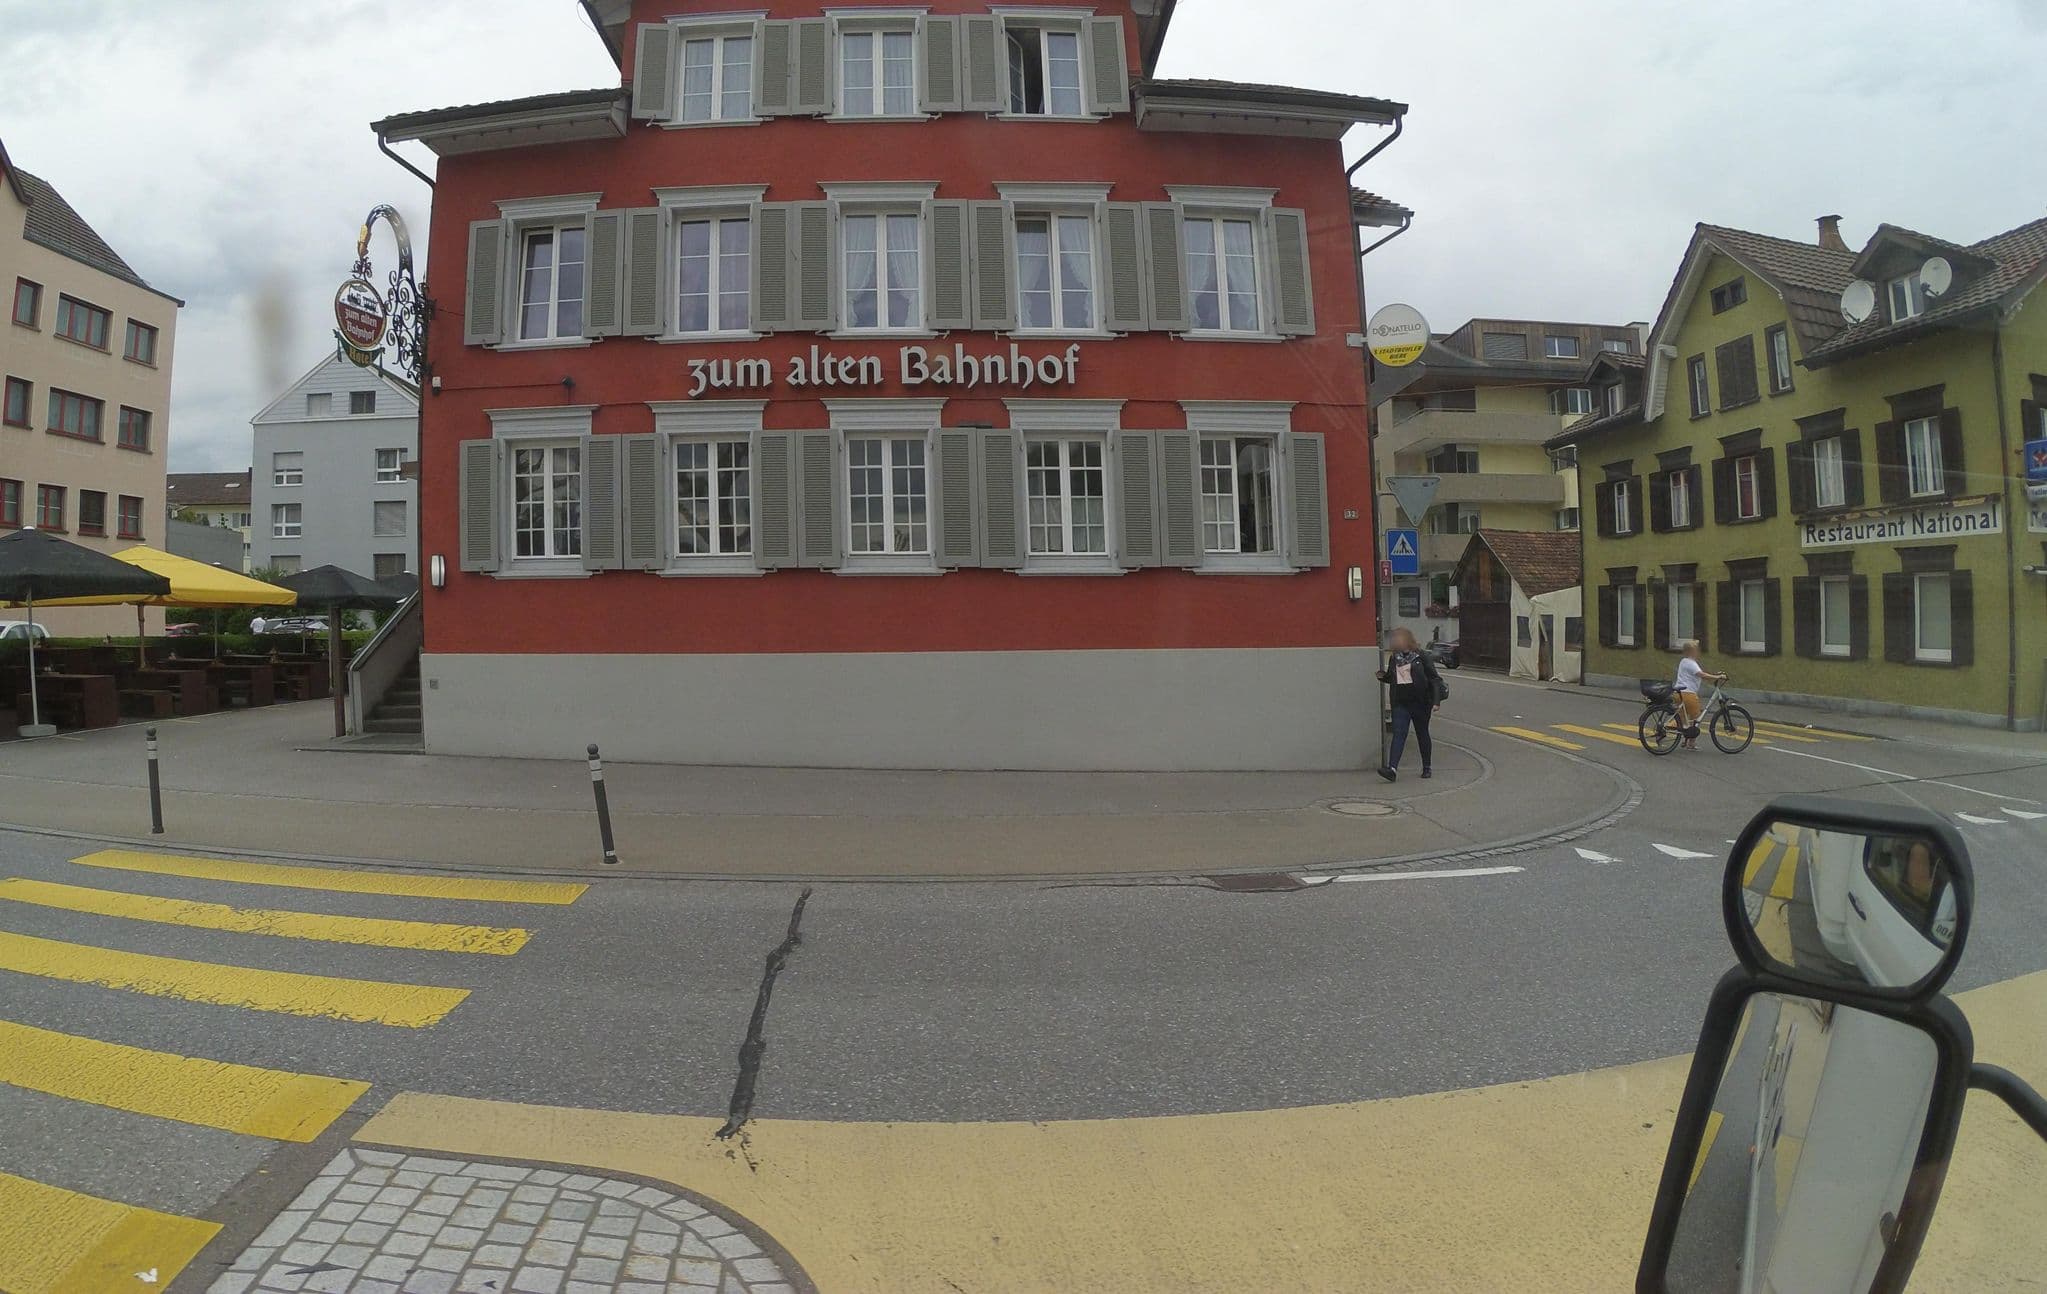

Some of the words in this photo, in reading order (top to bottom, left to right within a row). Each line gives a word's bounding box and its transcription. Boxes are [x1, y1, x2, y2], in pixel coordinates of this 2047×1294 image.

[349, 347, 373, 364] Hotel
[687, 358, 771, 397] zum
[785, 345, 883, 386] alten
[900, 343, 1080, 389] Bahnhof
[1806, 517, 1905, 544] Restaurant
[1912, 504, 1997, 534] National
